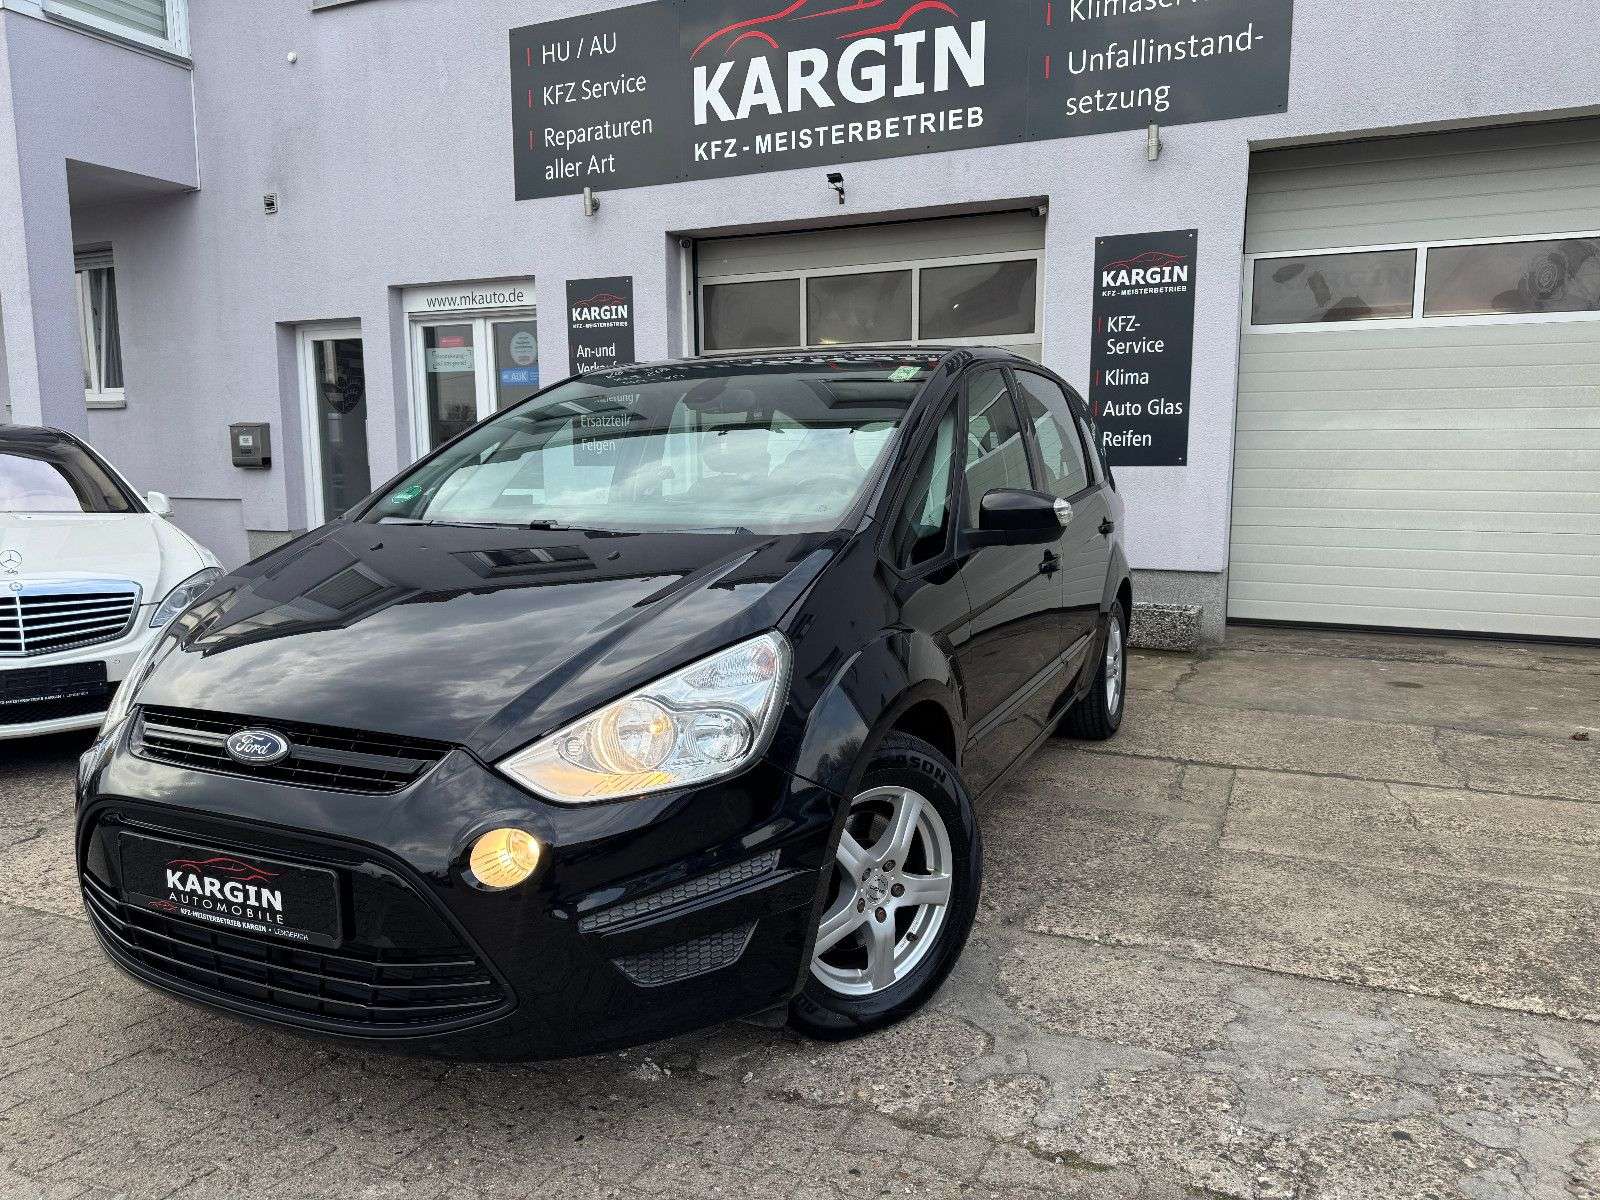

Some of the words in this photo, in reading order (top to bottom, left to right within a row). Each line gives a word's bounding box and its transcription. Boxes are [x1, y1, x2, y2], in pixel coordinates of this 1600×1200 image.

[542, 41, 570, 65] HU
[576, 38, 584, 59] /
[589, 32, 617, 57] AU
[1068, 22, 1264, 75] Unfallinstand-
[693, 19, 987, 127] KARGIN
[543, 82, 577, 106] KFZ
[581, 73, 647, 101] Service
[1065, 84, 1171, 116] setzung
[544, 118, 653, 151] Reparaturen
[545, 158, 582, 181] aller
[587, 154, 616, 175] Art
[1102, 265, 1189, 288] KARGIN
[426, 288, 524, 308] www.mkauto.de
[1102, 285, 1187, 297] KFZ-MEISTERBETRIEB
[572, 305, 628, 321] KARGIN
[1106, 315, 1141, 333] KFZ-
[577, 343, 616, 358] An-und
[1106, 337, 1165, 355] Service
[1105, 369, 1150, 386] Klima
[1102, 400, 1142, 417] Auto
[1147, 398, 1183, 416] Glas
[581, 437, 616, 454] Felgen
[1102, 430, 1152, 447] Reifen
[235, 734, 272, 755] Ford
[166, 868, 283, 912] KARGIN
[169, 891, 284, 925] AUTOMOBILE
